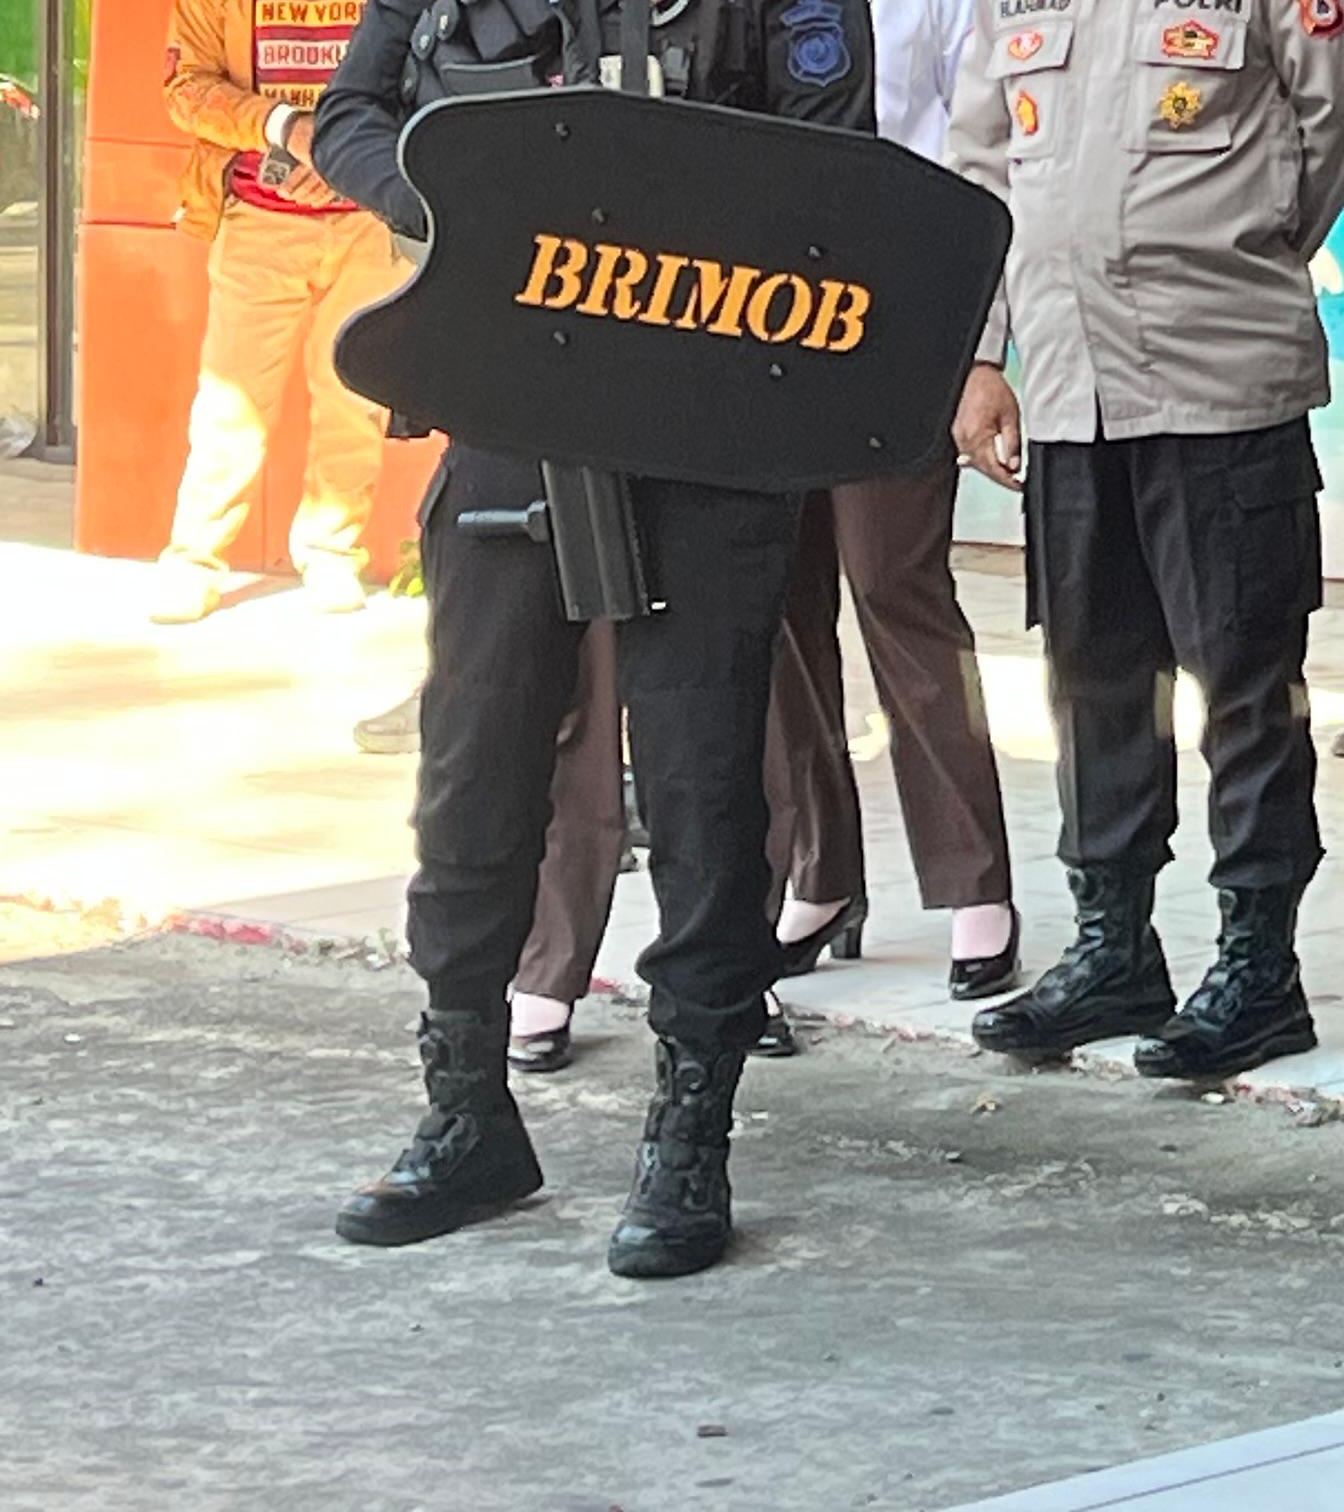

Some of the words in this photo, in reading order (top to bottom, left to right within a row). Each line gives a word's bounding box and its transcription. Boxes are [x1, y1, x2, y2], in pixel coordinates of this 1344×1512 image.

[262, 1, 308, 23] NEW
[315, 0, 364, 23] YOR
[515, 234, 871, 353] BRIMOB
